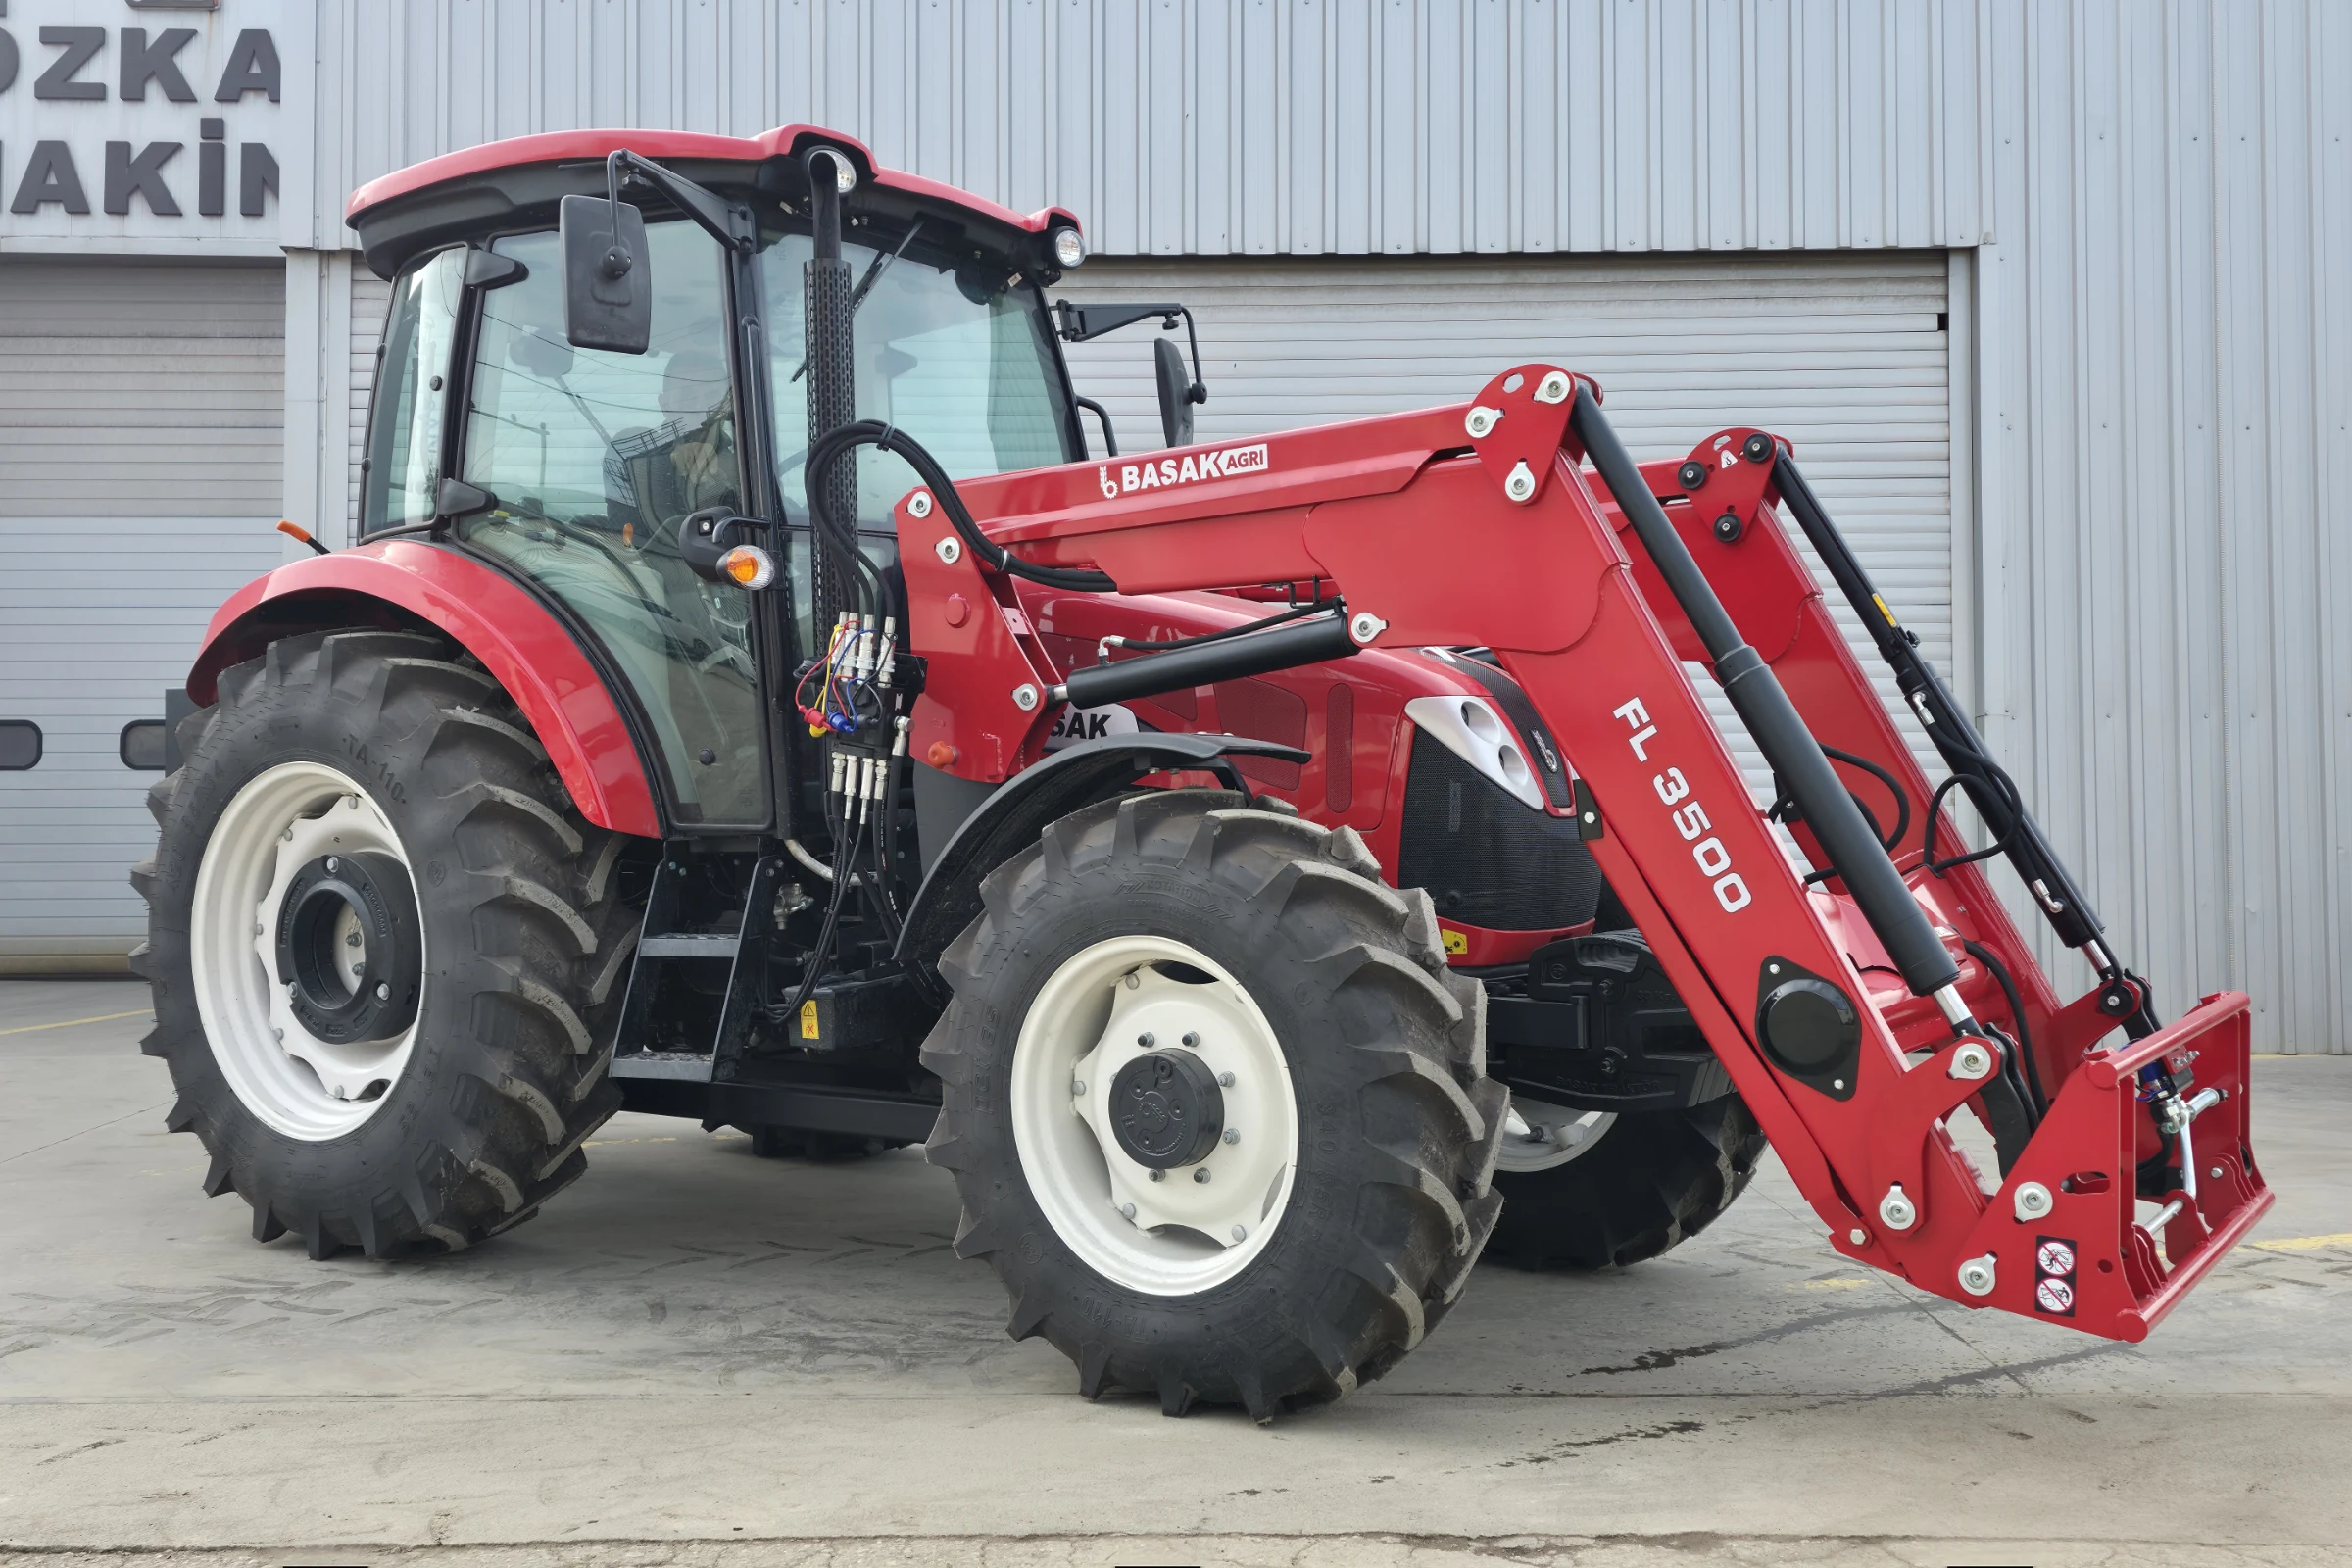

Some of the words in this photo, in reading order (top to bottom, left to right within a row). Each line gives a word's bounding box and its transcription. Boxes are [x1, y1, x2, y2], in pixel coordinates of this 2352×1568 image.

[0, 25, 280, 103] ZKA
[1225, 449, 1264, 470] AGRI
[1612, 696, 1658, 763] FL
[1652, 766, 1752, 913] 3500
[1145, 878, 1202, 903] ROTATION
